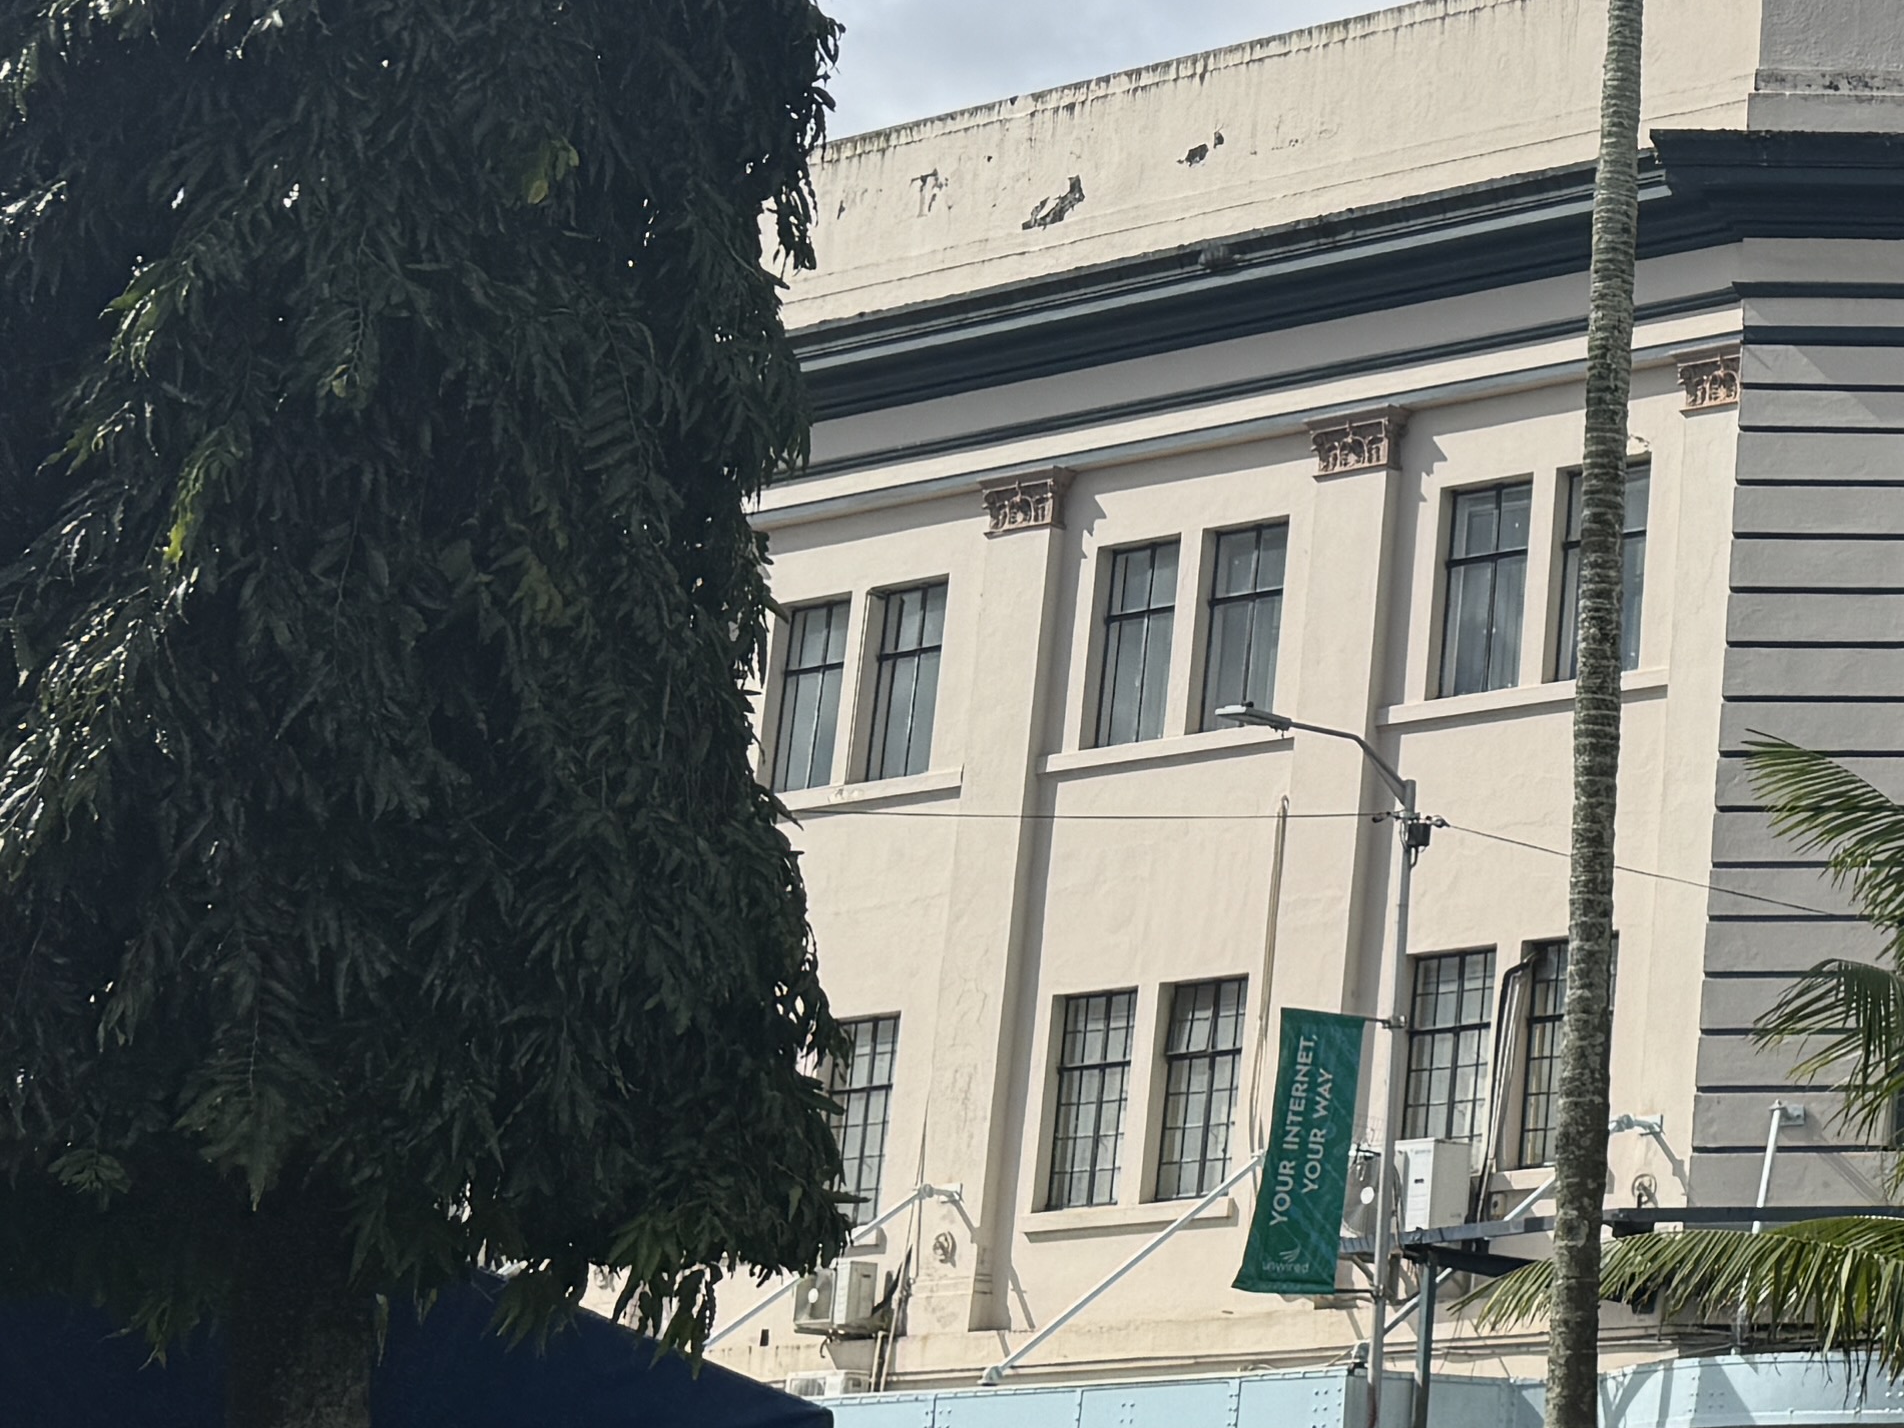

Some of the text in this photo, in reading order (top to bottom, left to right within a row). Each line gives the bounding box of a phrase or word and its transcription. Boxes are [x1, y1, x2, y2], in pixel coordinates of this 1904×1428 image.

[1269, 1034, 1318, 1226] YOUR INTERNET,
[1301, 1067, 1334, 1194] YOUR WAY
